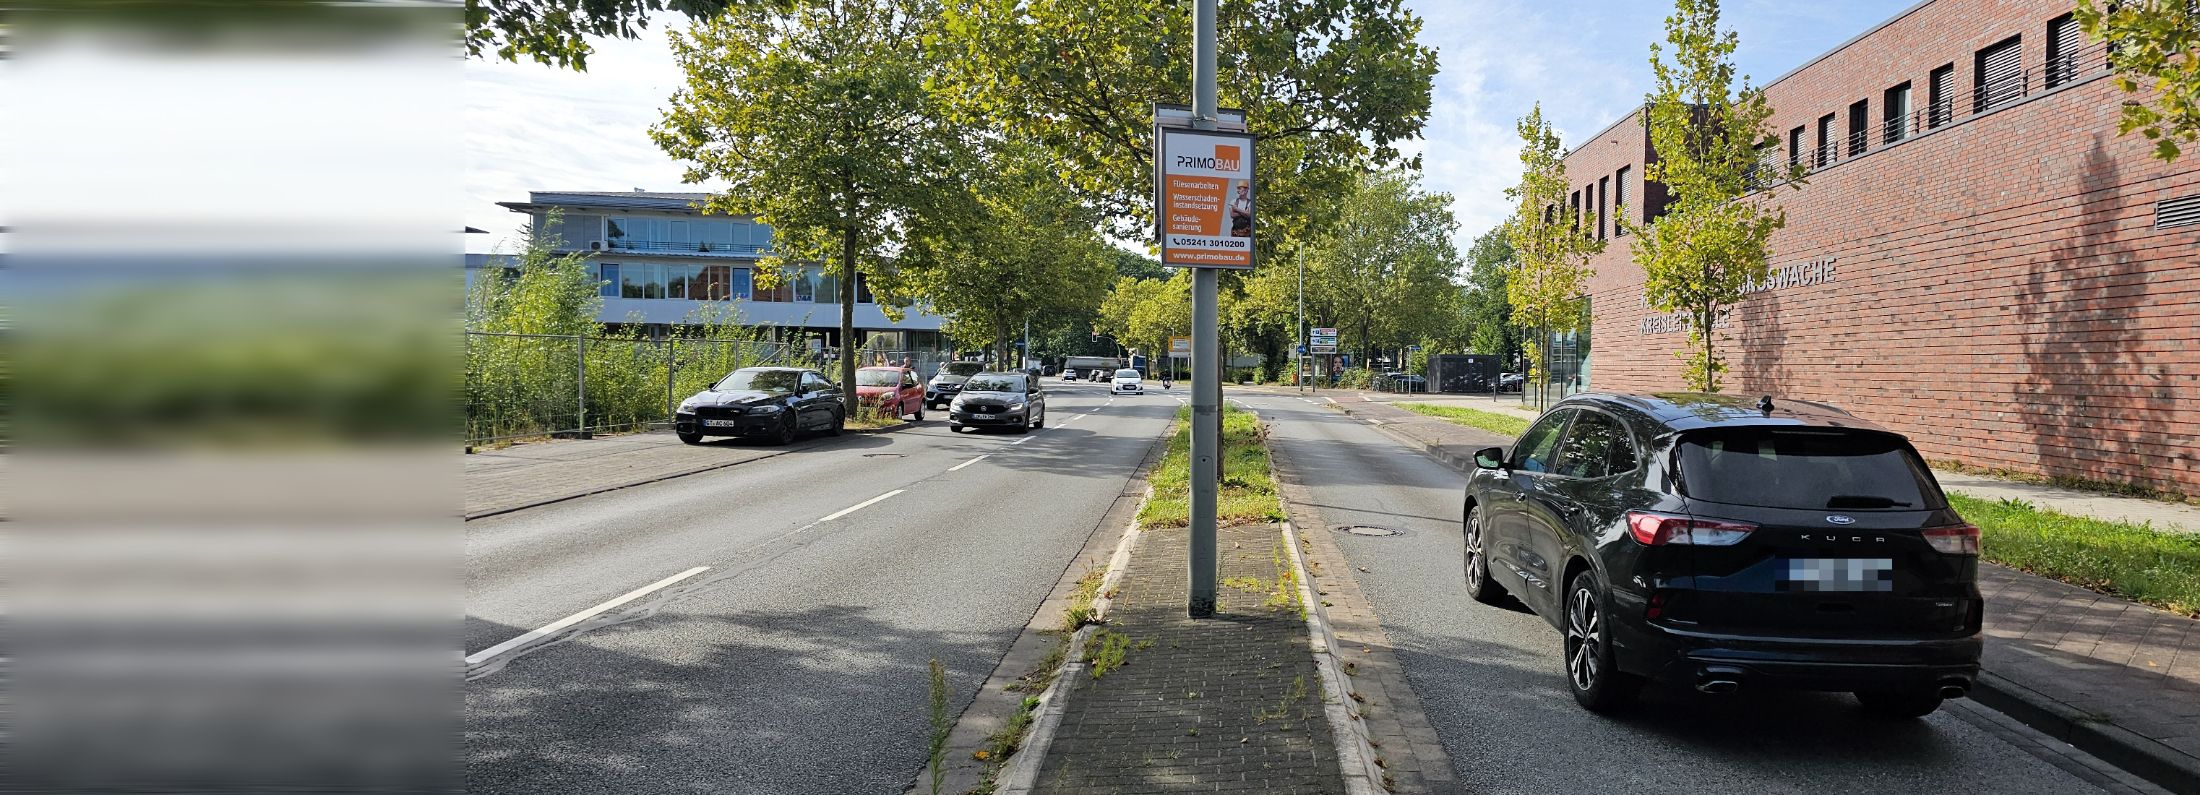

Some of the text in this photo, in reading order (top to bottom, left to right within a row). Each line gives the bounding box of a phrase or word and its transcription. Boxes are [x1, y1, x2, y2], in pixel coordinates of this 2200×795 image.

[1177, 155, 1240, 171] PRIMOBAU
[1173, 180, 1219, 190] Fliesenarbeiten
[1173, 193, 1220, 203] Wasserschaden-
[1172, 214, 1201, 223] Gebäude-
[1172, 223, 1202, 232] sanierung
[1181, 238, 1245, 248] 05241 3010200
[1173, 253, 1245, 261] www.primobau.de
